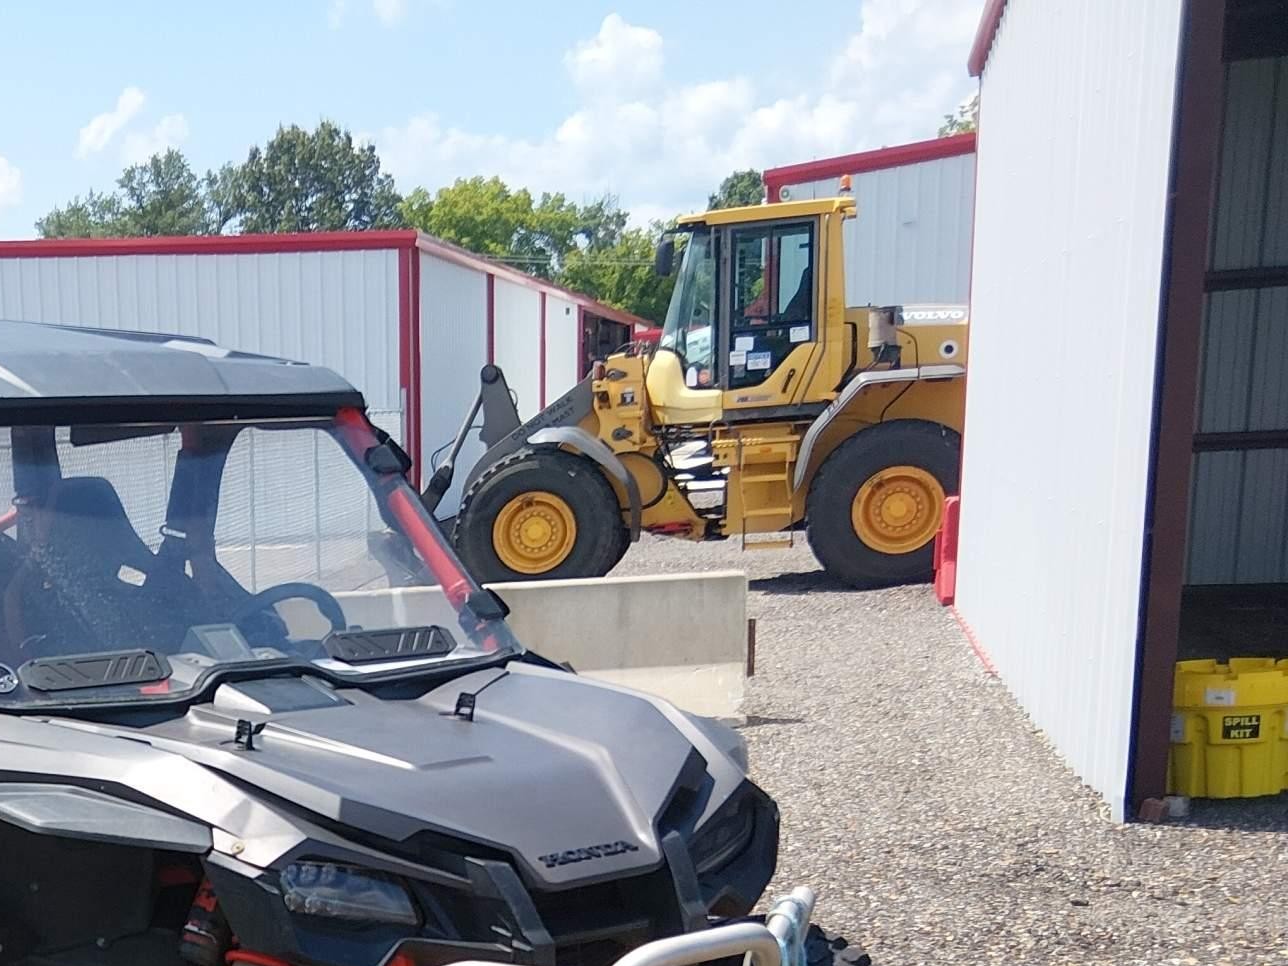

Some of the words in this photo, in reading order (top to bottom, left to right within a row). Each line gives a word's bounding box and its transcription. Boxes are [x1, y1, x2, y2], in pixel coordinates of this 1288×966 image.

[901, 310, 964, 320] VOLVO
[547, 395, 573, 416] WALK
[1225, 716, 1258, 726] SPILL
[1230, 729, 1252, 738] KIT
[538, 841, 639, 868] HONDA
